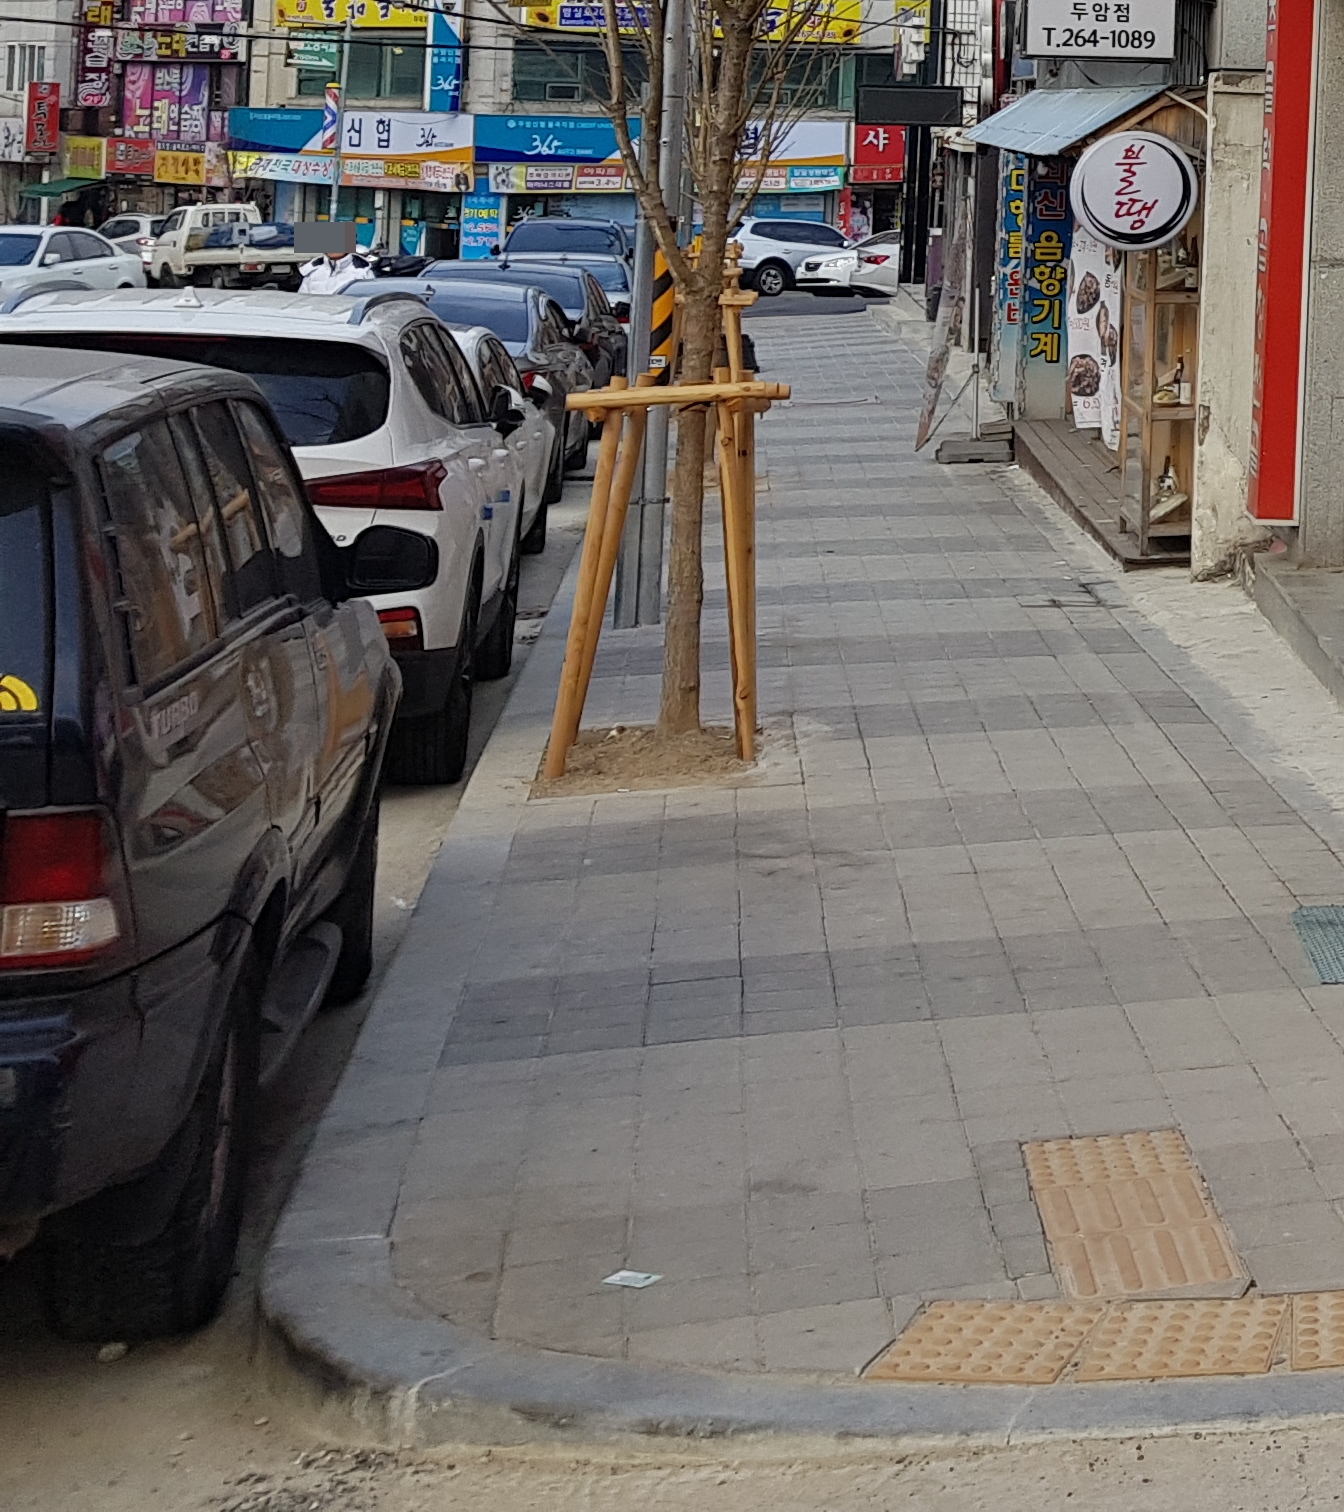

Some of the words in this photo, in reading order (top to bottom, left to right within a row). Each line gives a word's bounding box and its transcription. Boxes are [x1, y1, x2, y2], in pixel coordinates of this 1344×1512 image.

[1070, 2, 1131, 23] 두암점
[1042, 27, 1156, 49] T.264-1089
[347, 117, 391, 148] 신협
[1030, 230, 1067, 364] 음향기계
[150, 691, 199, 739] TURBO
